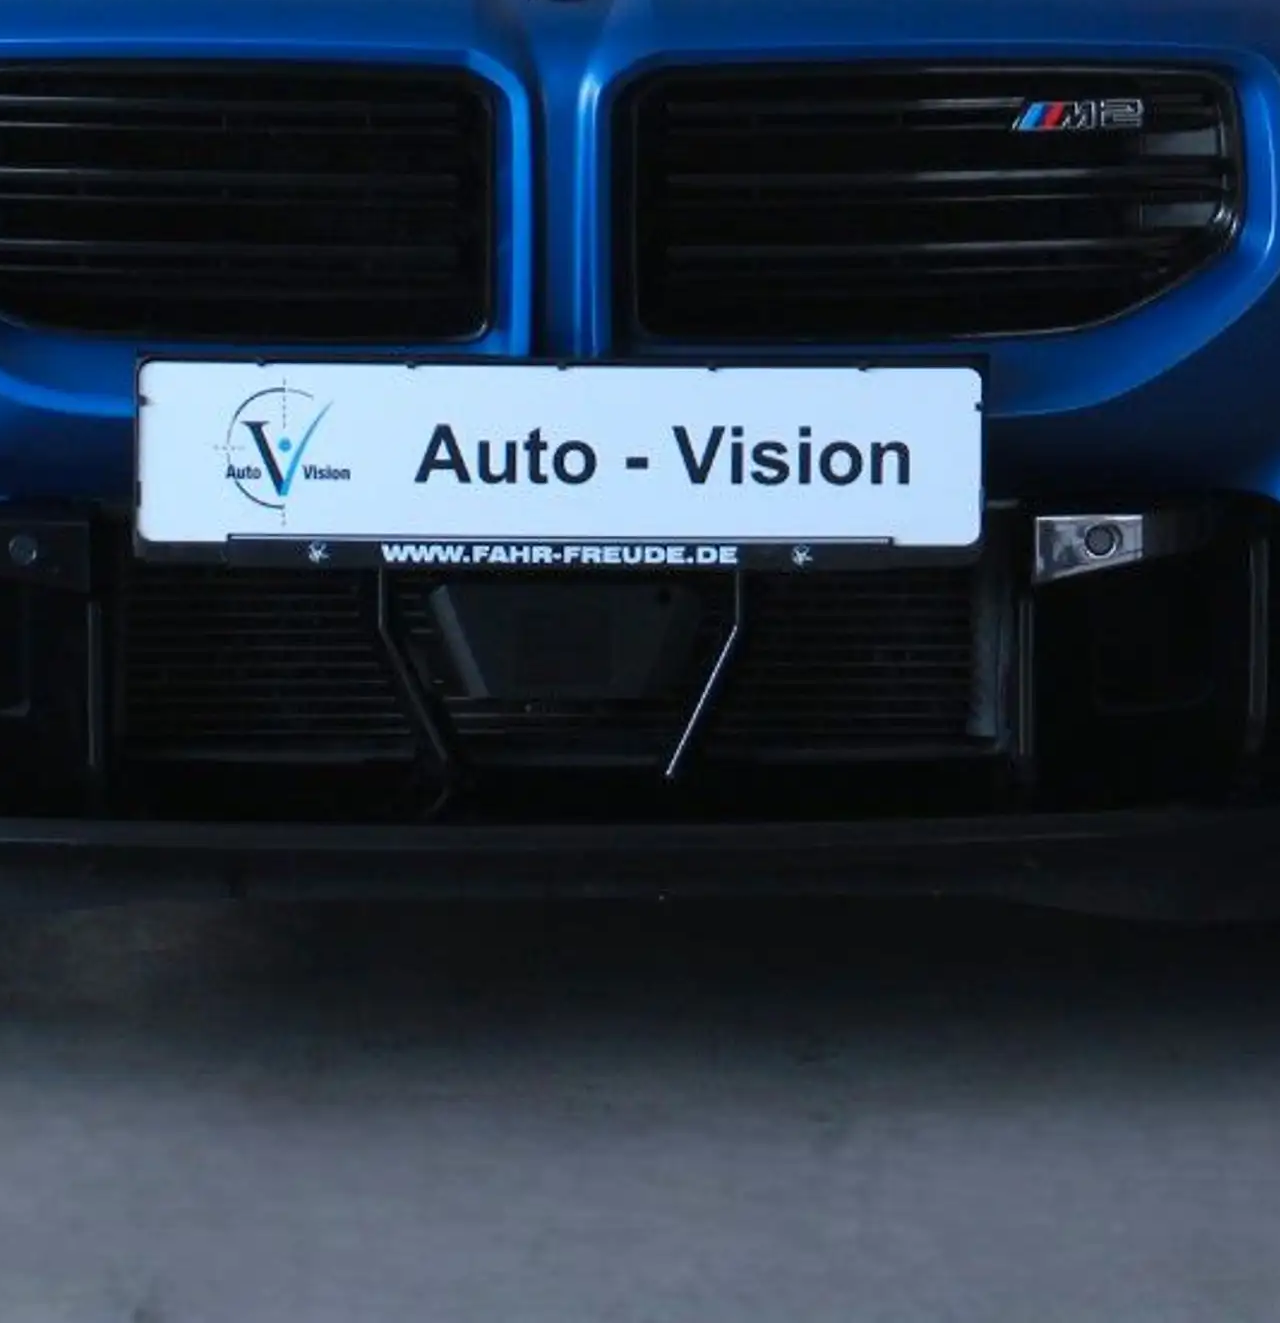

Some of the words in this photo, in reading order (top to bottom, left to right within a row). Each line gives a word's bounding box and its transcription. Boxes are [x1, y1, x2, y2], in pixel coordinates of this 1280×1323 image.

[1052, 97, 1145, 128] M2
[414, 424, 598, 486] Auto
[672, 425, 912, 486] Vision
[225, 464, 262, 479] Auto
[303, 464, 352, 480] Vision
[381, 544, 739, 565] WWW.FAHR-FREUDE.DE
